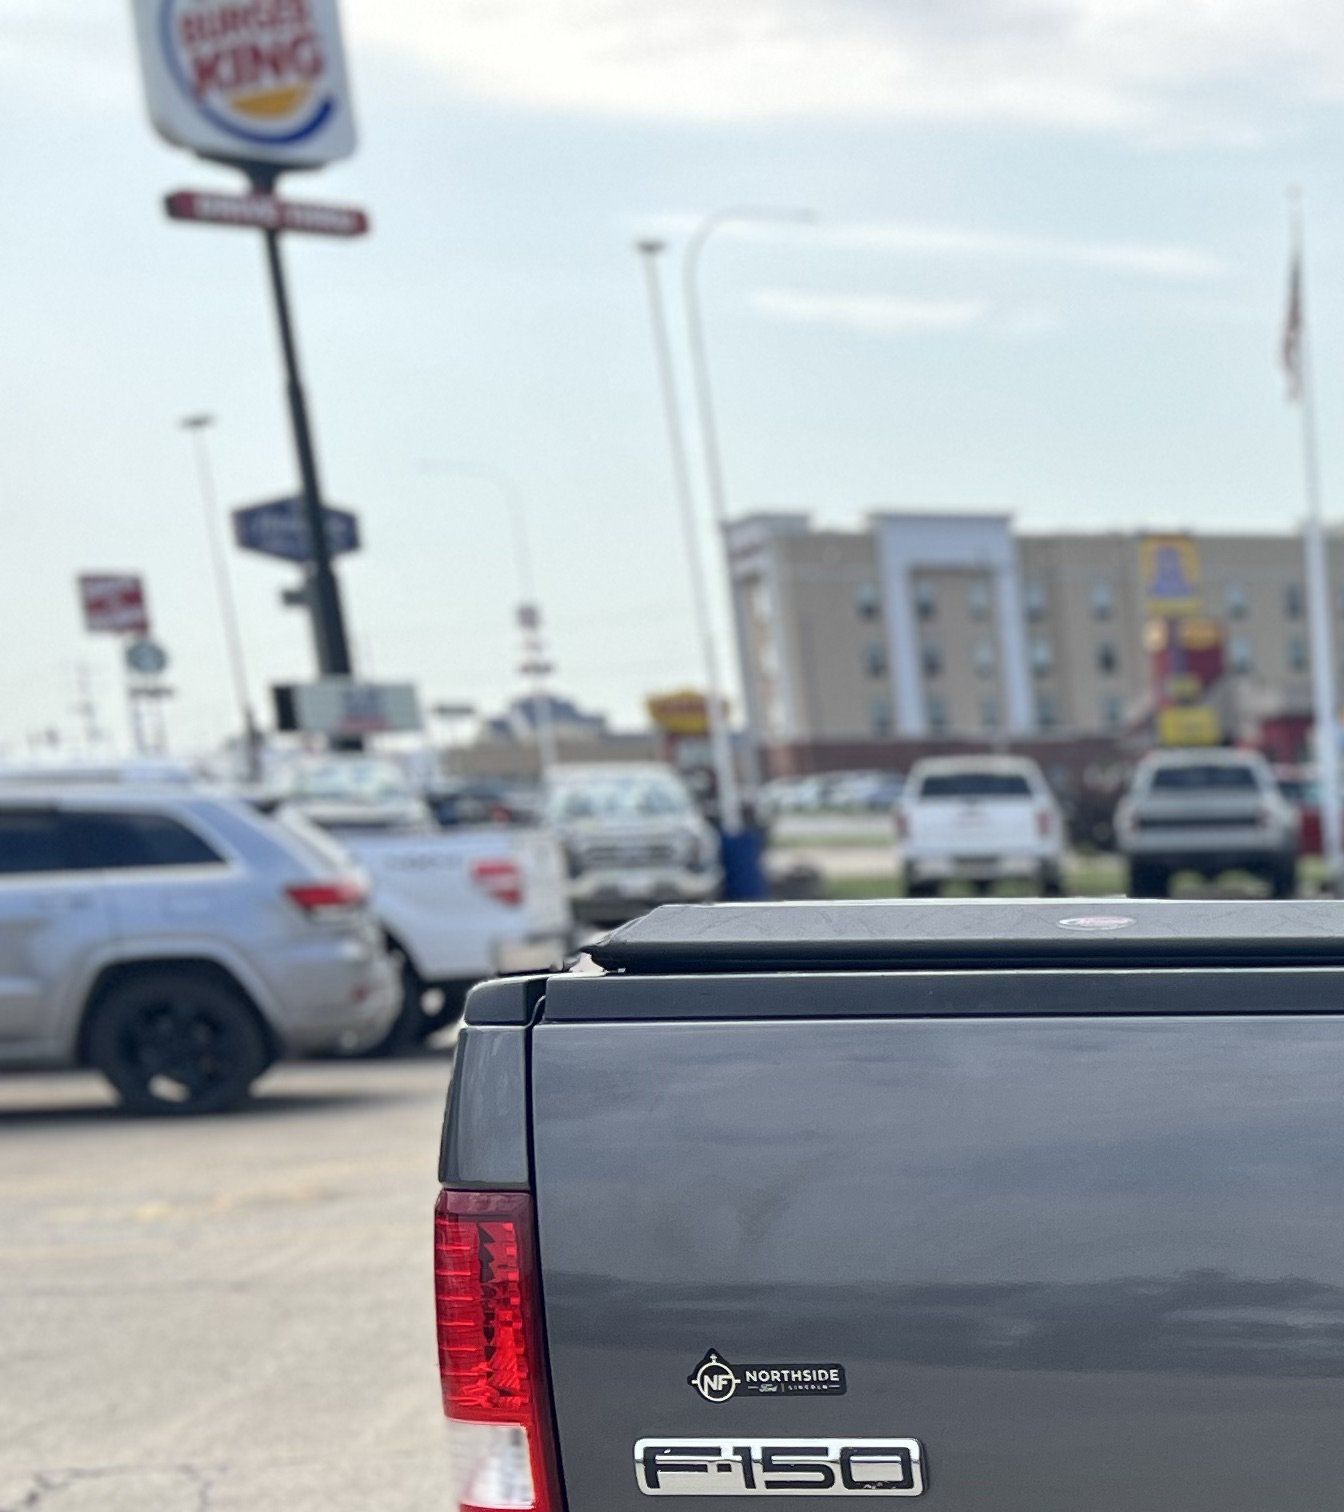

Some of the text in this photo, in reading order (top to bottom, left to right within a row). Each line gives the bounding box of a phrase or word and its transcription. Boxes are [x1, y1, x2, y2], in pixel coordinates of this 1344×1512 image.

[194, 32, 324, 101] KING
[703, 1374, 734, 1397] NF
[745, 1369, 840, 1383] NORTHSIDE
